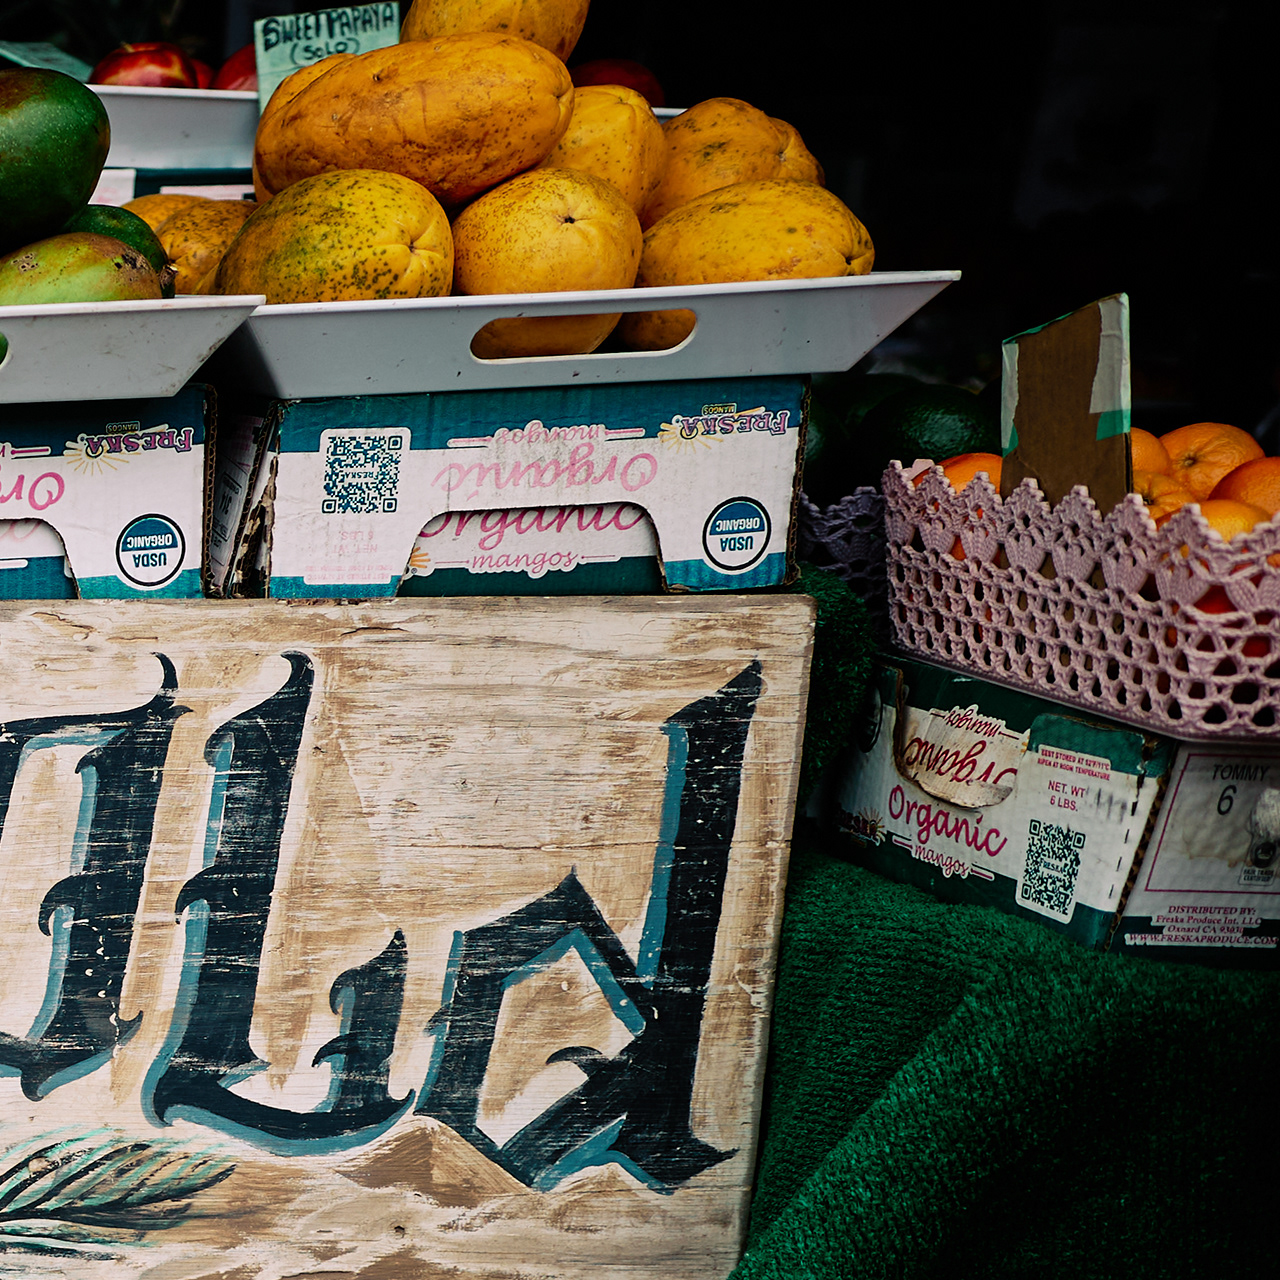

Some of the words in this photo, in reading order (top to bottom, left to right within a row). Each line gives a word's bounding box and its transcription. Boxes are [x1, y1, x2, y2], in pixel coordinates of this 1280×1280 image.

[263, 11, 322, 51] SWEET
[325, 3, 394, 39] PAPAYA
[431, 442, 658, 500] Organic
[715, 517, 760, 532] ORGANIC
[126, 533, 173, 548] ORGANIC
[719, 536, 754, 552] USDA
[132, 552, 167, 568] USDA
[472, 552, 579, 573] mangos
[1212, 764, 1270, 782] TOMMY
[1048, 780, 1067, 795] NET.
[1071, 785, 1086, 798] WT
[1050, 795, 1056, 805] 6
[1057, 797, 1078, 812] LBS.
[1216, 784, 1237, 816] 6
[888, 785, 1008, 857] Organic
[914, 843, 970, 877] mangos
[1168, 905, 1238, 915] DISTRIBUTED
[1239, 907, 1256, 915] BY:
[1156, 915, 1185, 923] Freska
[1186, 916, 1222, 924] Produce
[1167, 925, 1200, 933] Oxnard
[1202, 926, 1216, 934] CA
